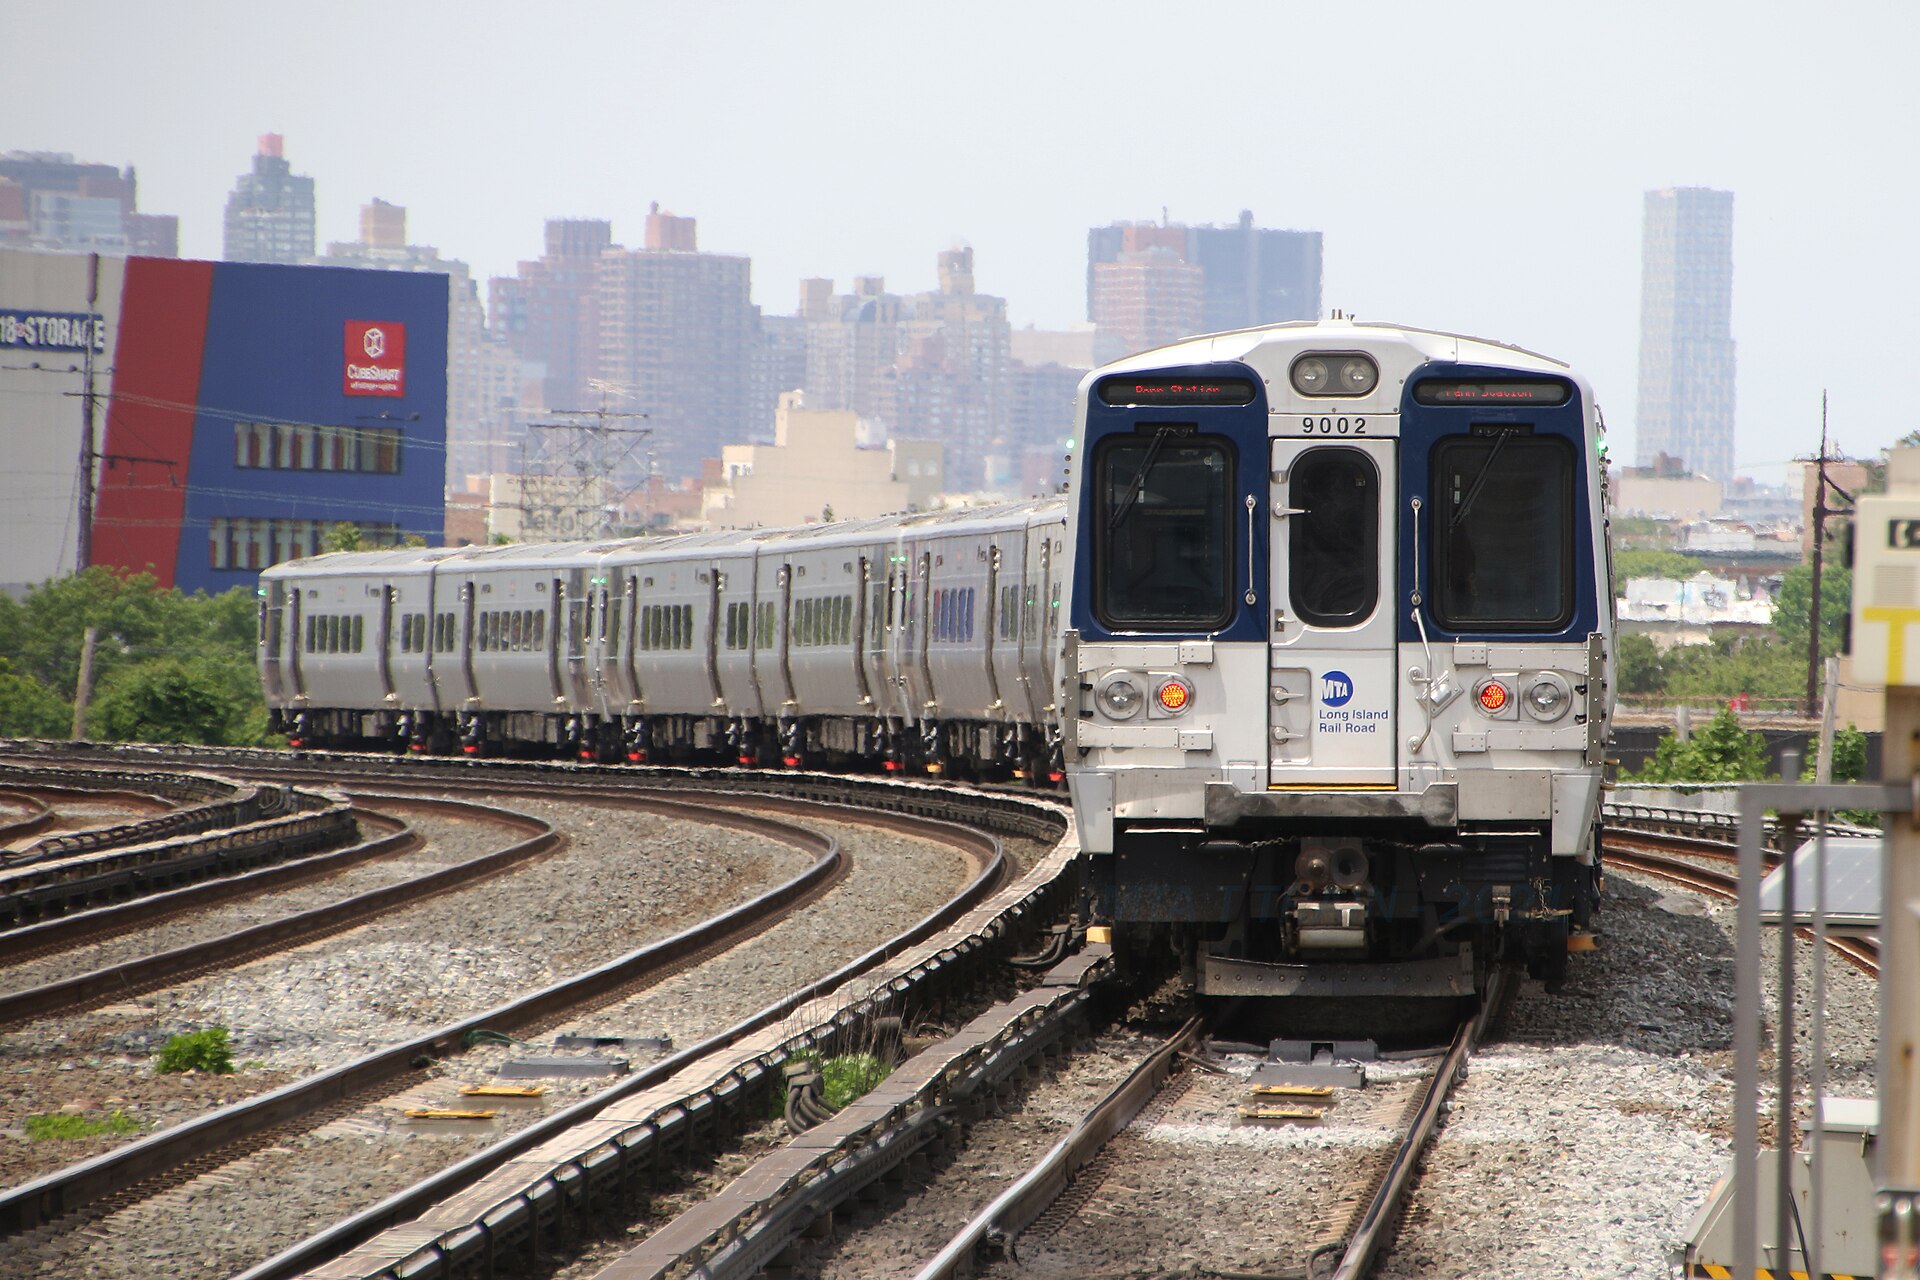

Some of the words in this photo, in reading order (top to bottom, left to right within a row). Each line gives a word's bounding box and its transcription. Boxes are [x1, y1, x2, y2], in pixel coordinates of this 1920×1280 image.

[1302, 417, 1366, 434] 9002
[1320, 678, 1348, 700] MTA
[1319, 709, 1349, 722] Long
[1352, 709, 1389, 720] Island
[1319, 722, 1341, 733] Rail
[1345, 722, 1376, 733] Road
